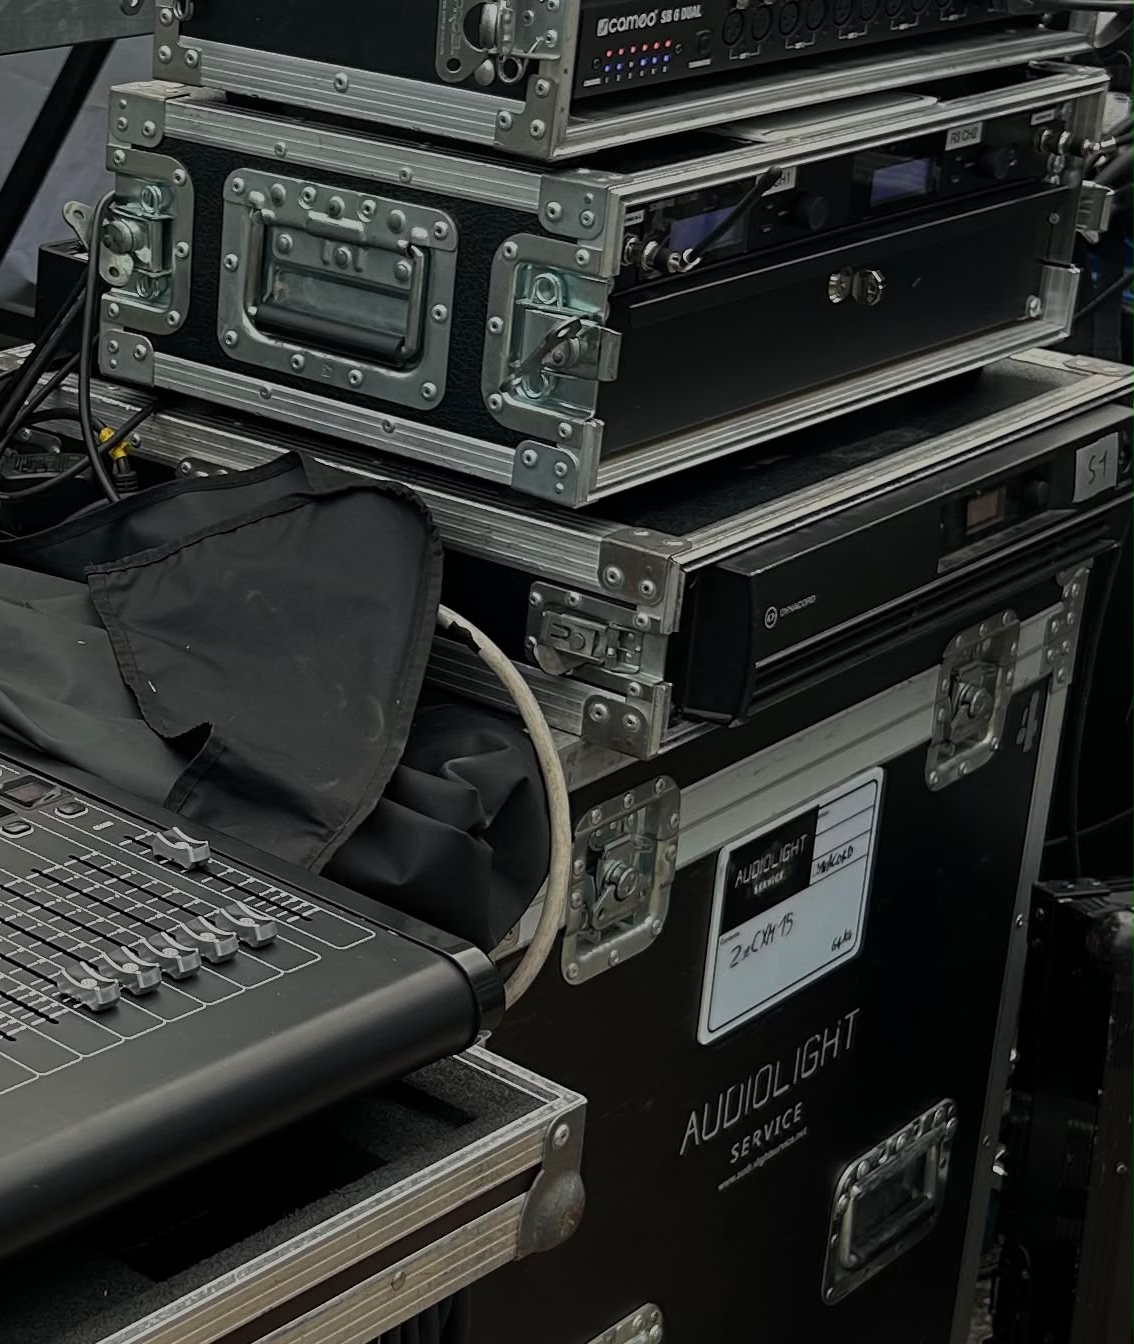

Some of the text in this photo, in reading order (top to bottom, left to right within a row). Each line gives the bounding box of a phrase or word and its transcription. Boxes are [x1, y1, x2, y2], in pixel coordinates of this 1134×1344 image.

[608, 11, 657, 35] cameo
[734, 833, 808, 889] AUDIOLIGHT
[679, 1007, 861, 1156] AUDIOLIGHT
[729, 1101, 803, 1164] SERVICE
